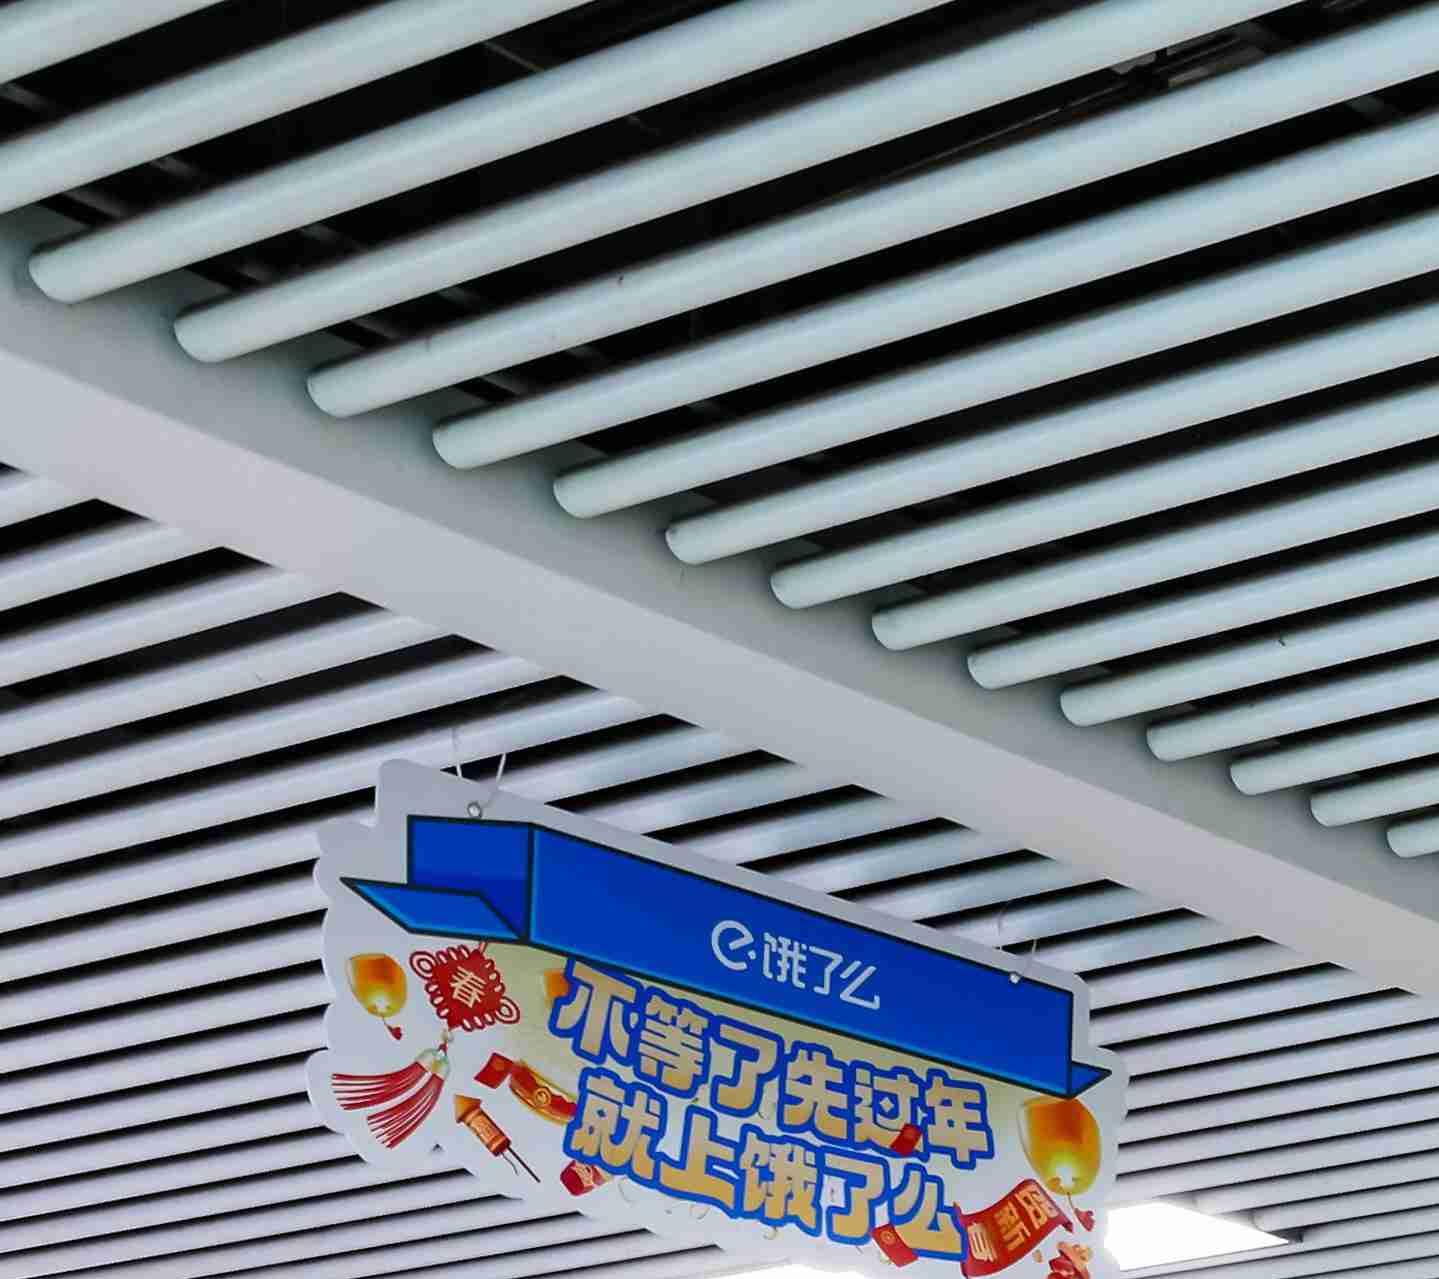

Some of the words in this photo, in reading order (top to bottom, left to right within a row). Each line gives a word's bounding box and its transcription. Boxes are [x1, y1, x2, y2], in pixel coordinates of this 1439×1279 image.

[450, 966, 487, 1008] 春
[550, 961, 990, 1168] 不等了先过年
[572, 1074, 962, 1258] 就上饿了么
